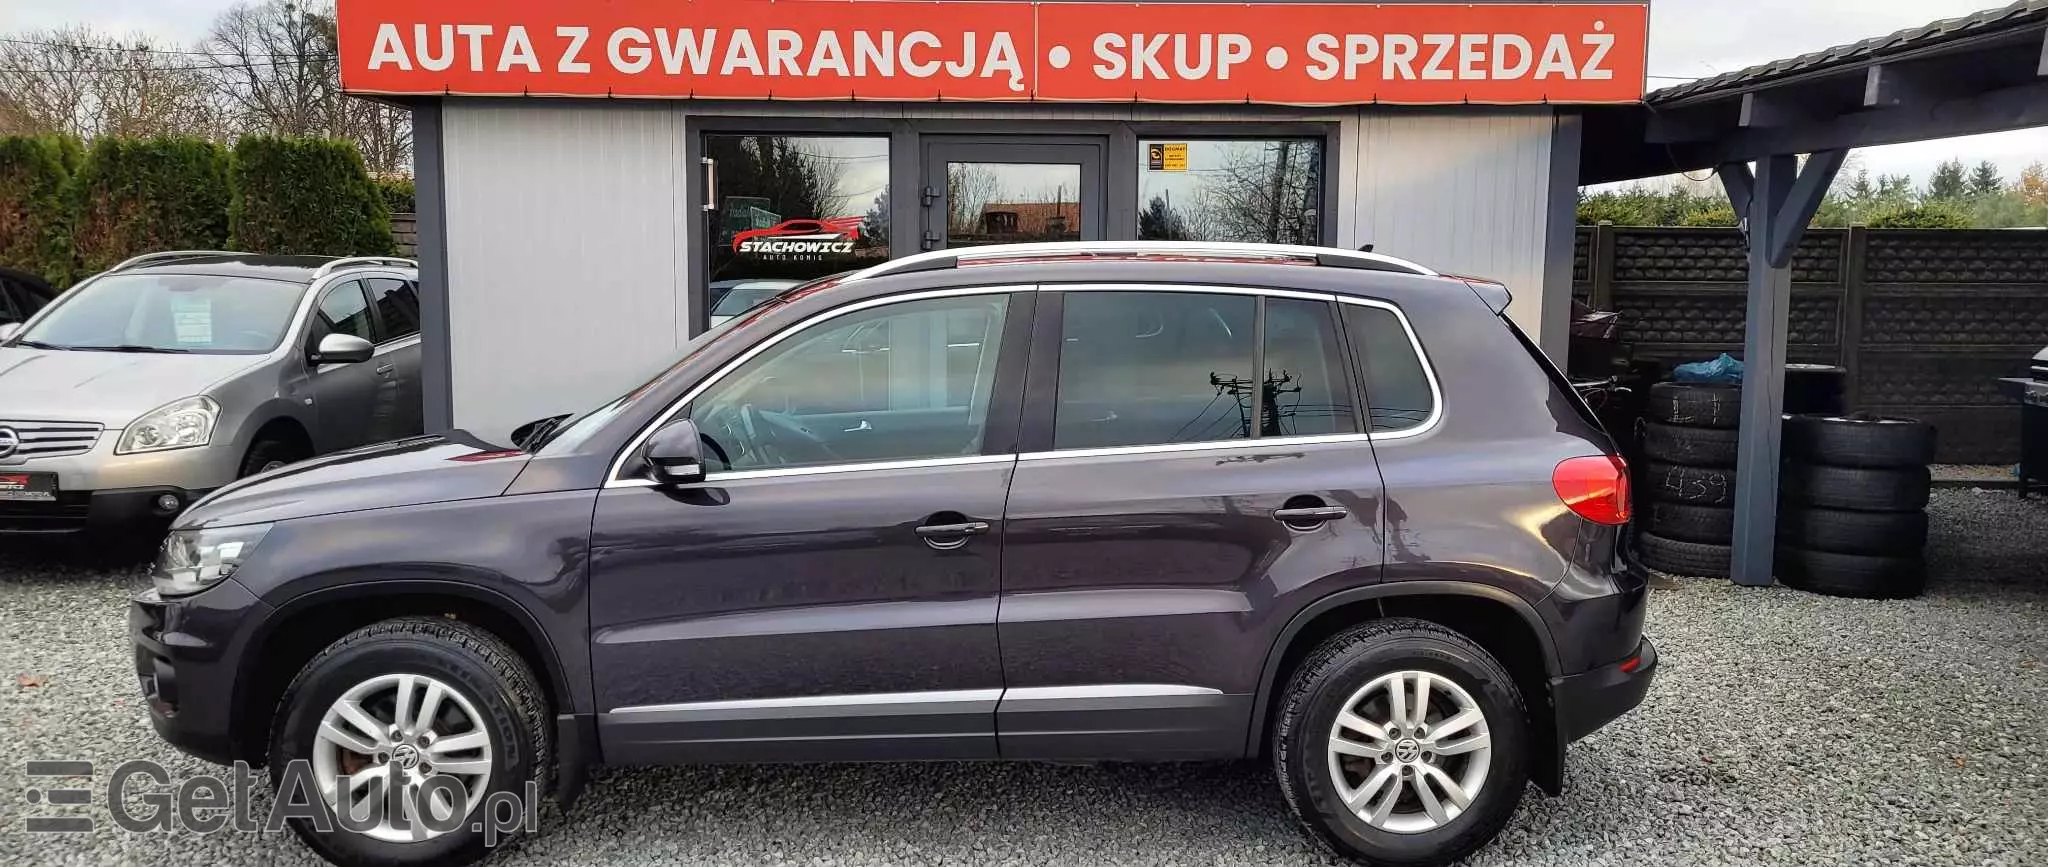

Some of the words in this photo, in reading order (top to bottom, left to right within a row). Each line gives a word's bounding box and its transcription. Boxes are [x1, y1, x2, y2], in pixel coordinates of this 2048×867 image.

[367, 23, 541, 73] AUTA
[556, 26, 591, 73] Z
[607, 27, 1025, 92] GWARANCJĄ
[1092, 32, 1253, 81] SKUP
[1305, 20, 1615, 81] SPRZEDAŻ
[740, 241, 854, 253] STACHOWICZ
